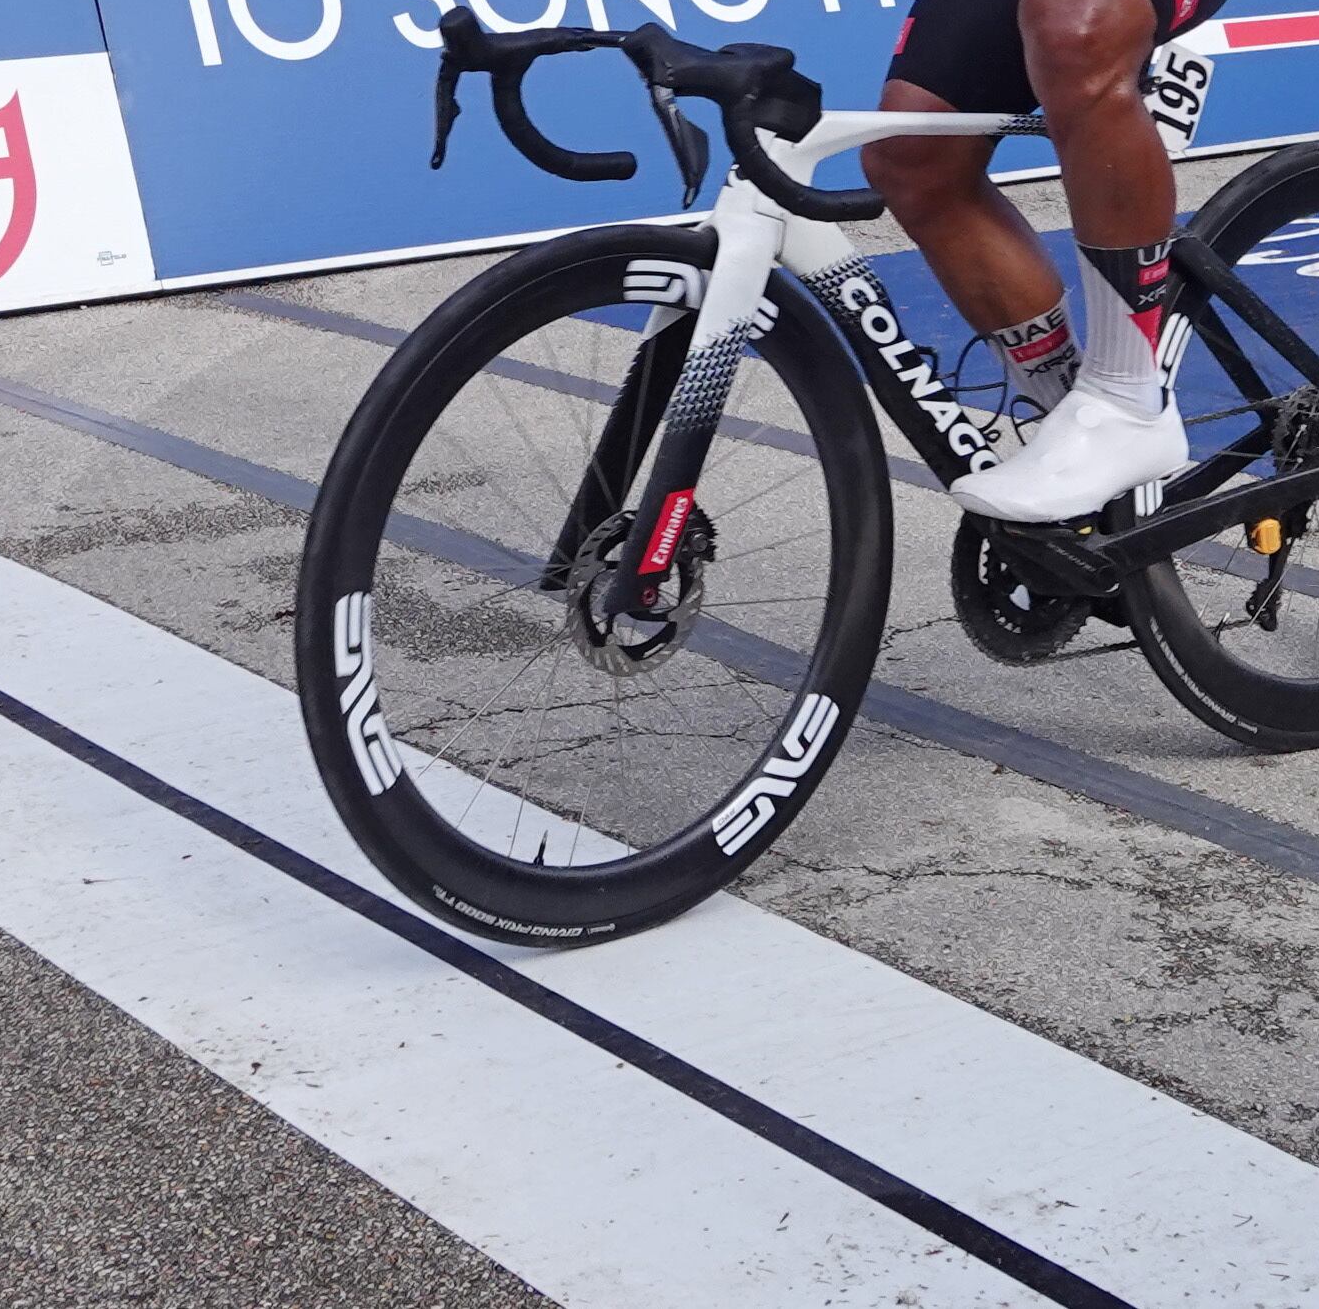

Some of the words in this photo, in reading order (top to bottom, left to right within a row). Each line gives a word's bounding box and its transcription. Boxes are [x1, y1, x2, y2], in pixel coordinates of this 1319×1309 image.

[1150, 51, 1208, 141] 195
[1138, 284, 1168, 306] XR
[997, 307, 1066, 348] UAE
[650, 495, 689, 565] Emirates
[494, 916, 532, 934] PRIX
